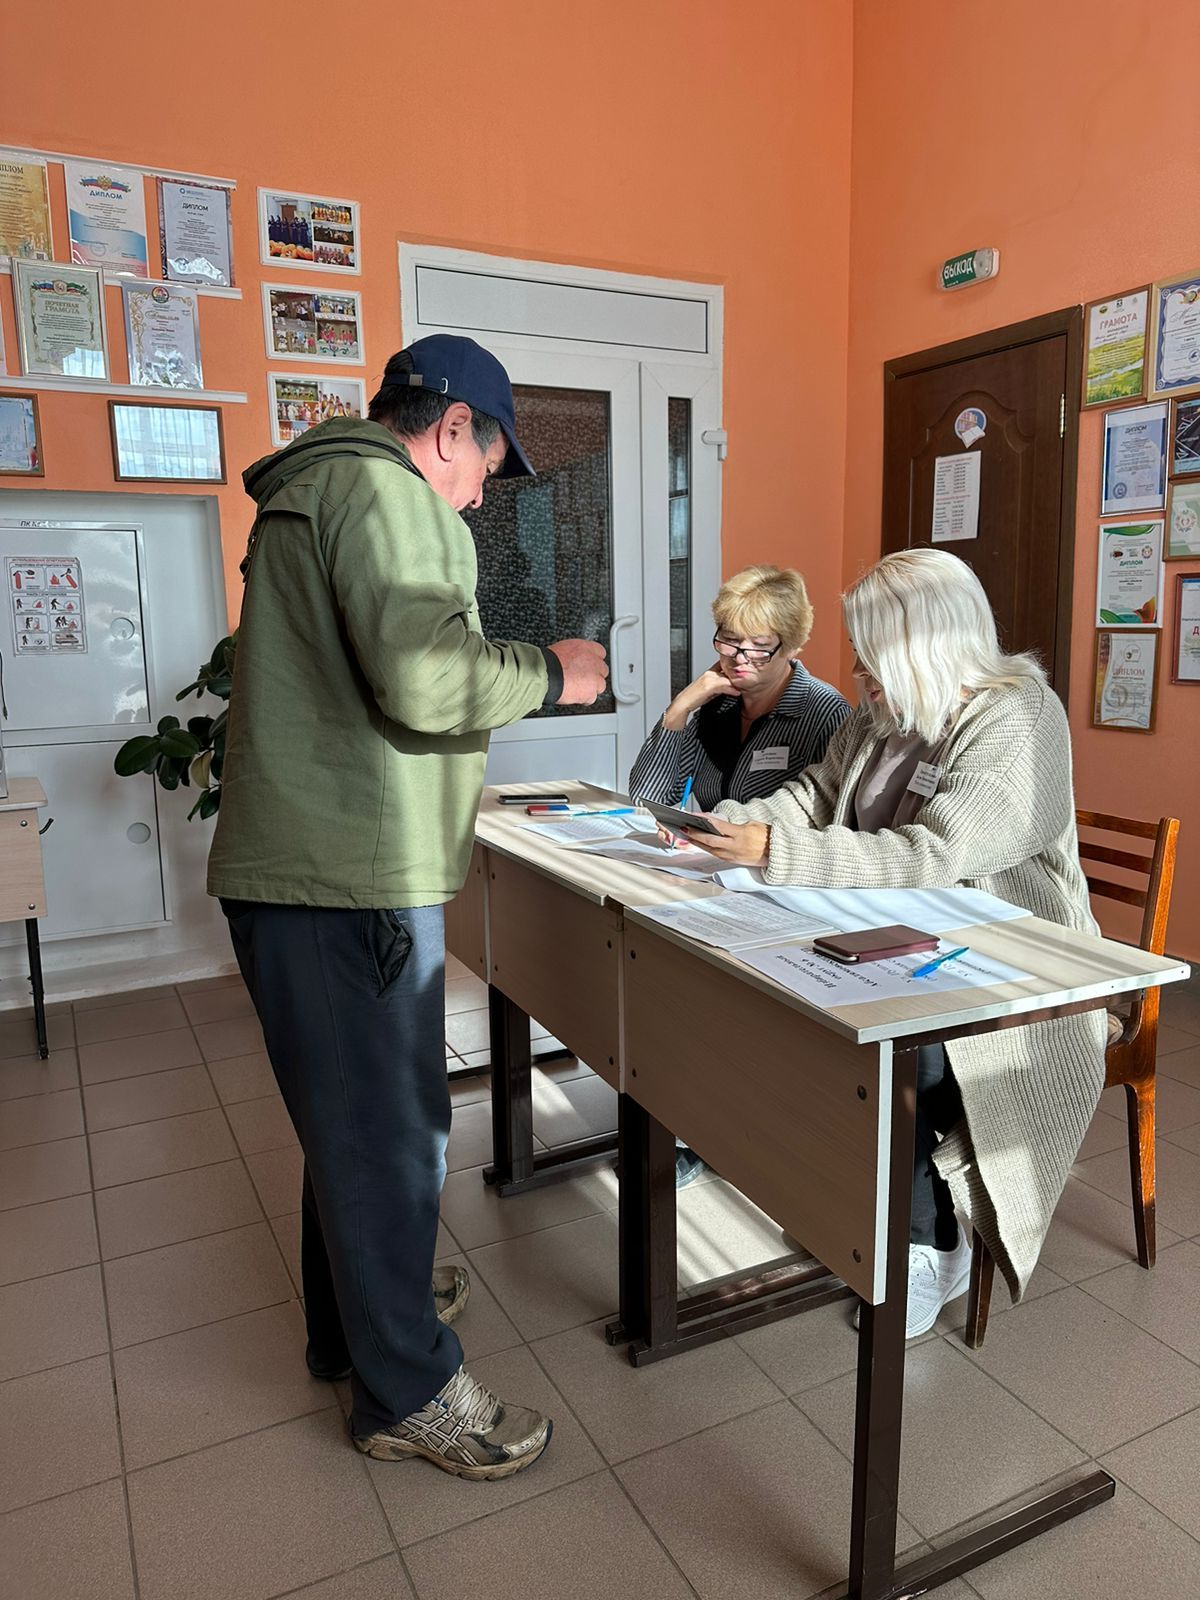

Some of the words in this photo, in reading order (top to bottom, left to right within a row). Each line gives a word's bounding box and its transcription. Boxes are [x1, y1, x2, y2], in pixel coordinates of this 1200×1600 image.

[89, 190, 123, 200] ДИПЛОМ
[182, 202, 209, 212] ДИПЛОМ
[943, 257, 974, 280] ВЫХОД
[1099, 313, 1138, 330] ГРАМОТА
